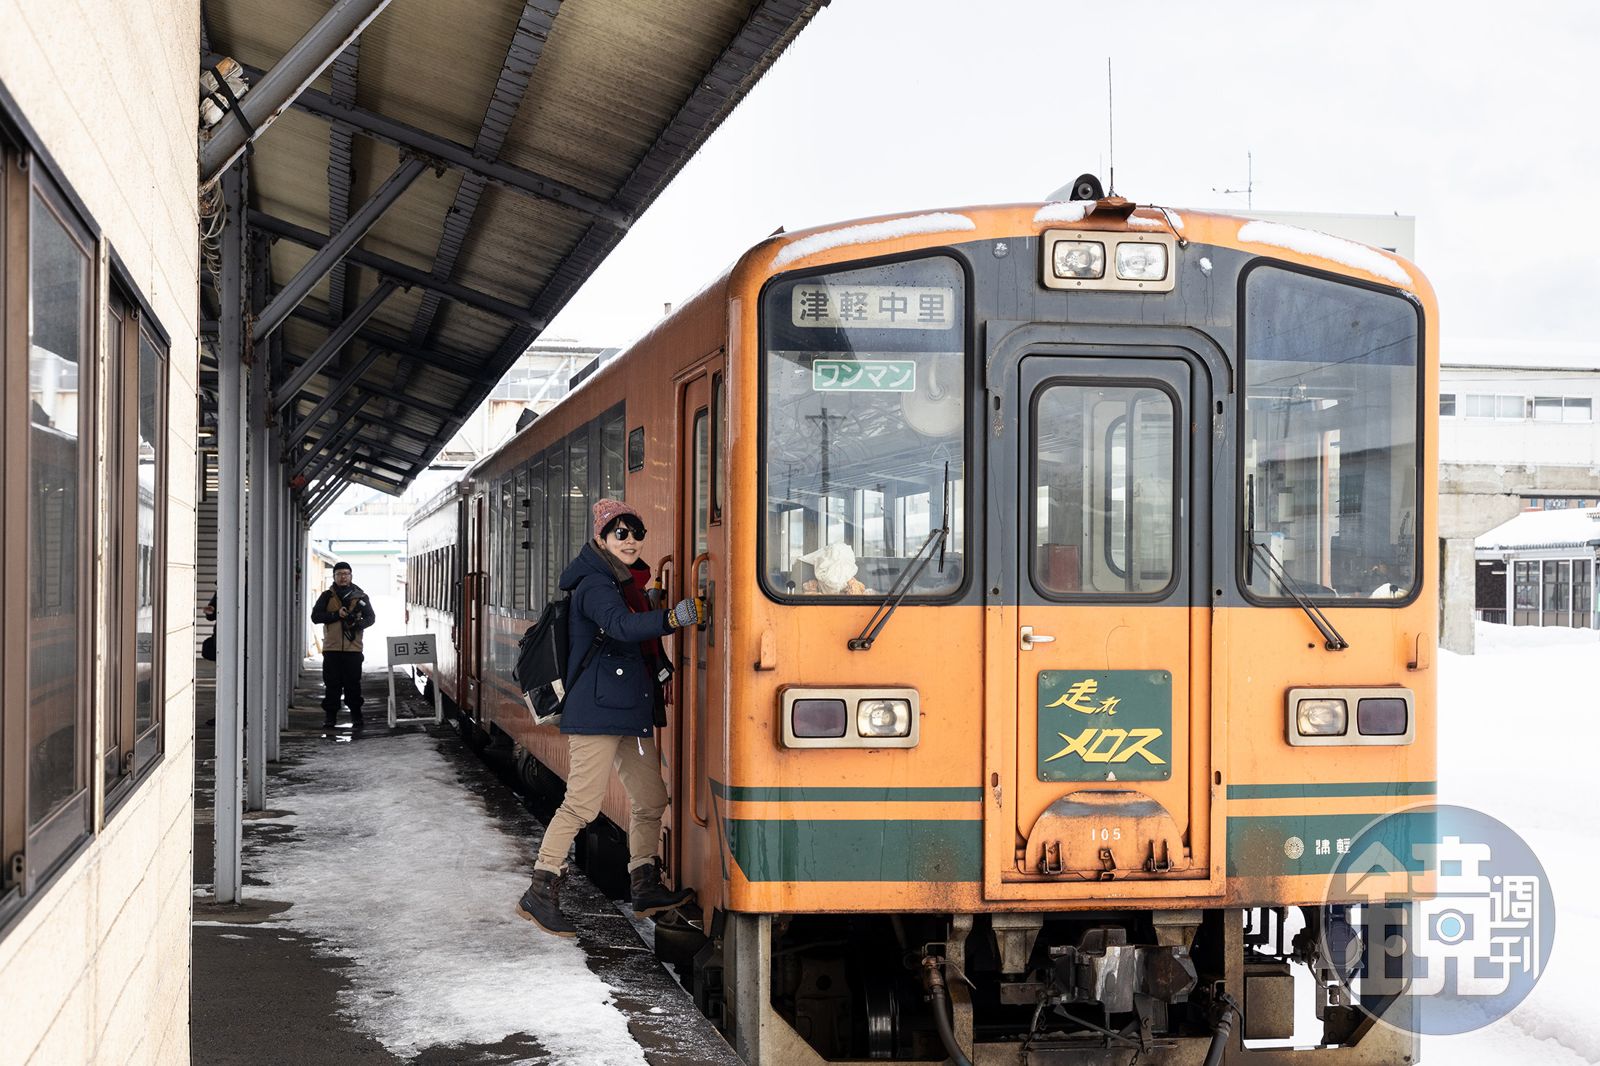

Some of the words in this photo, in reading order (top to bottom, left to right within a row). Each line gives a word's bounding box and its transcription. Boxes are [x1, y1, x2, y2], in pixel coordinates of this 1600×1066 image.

[800, 290, 945, 323] 津軽中里
[817, 364, 912, 388] ワンマン
[394, 641, 430, 656] 回送
[1044, 678, 1122, 715] 走れ
[1043, 728, 1167, 764] メロス
[1090, 828, 1121, 841] 105
